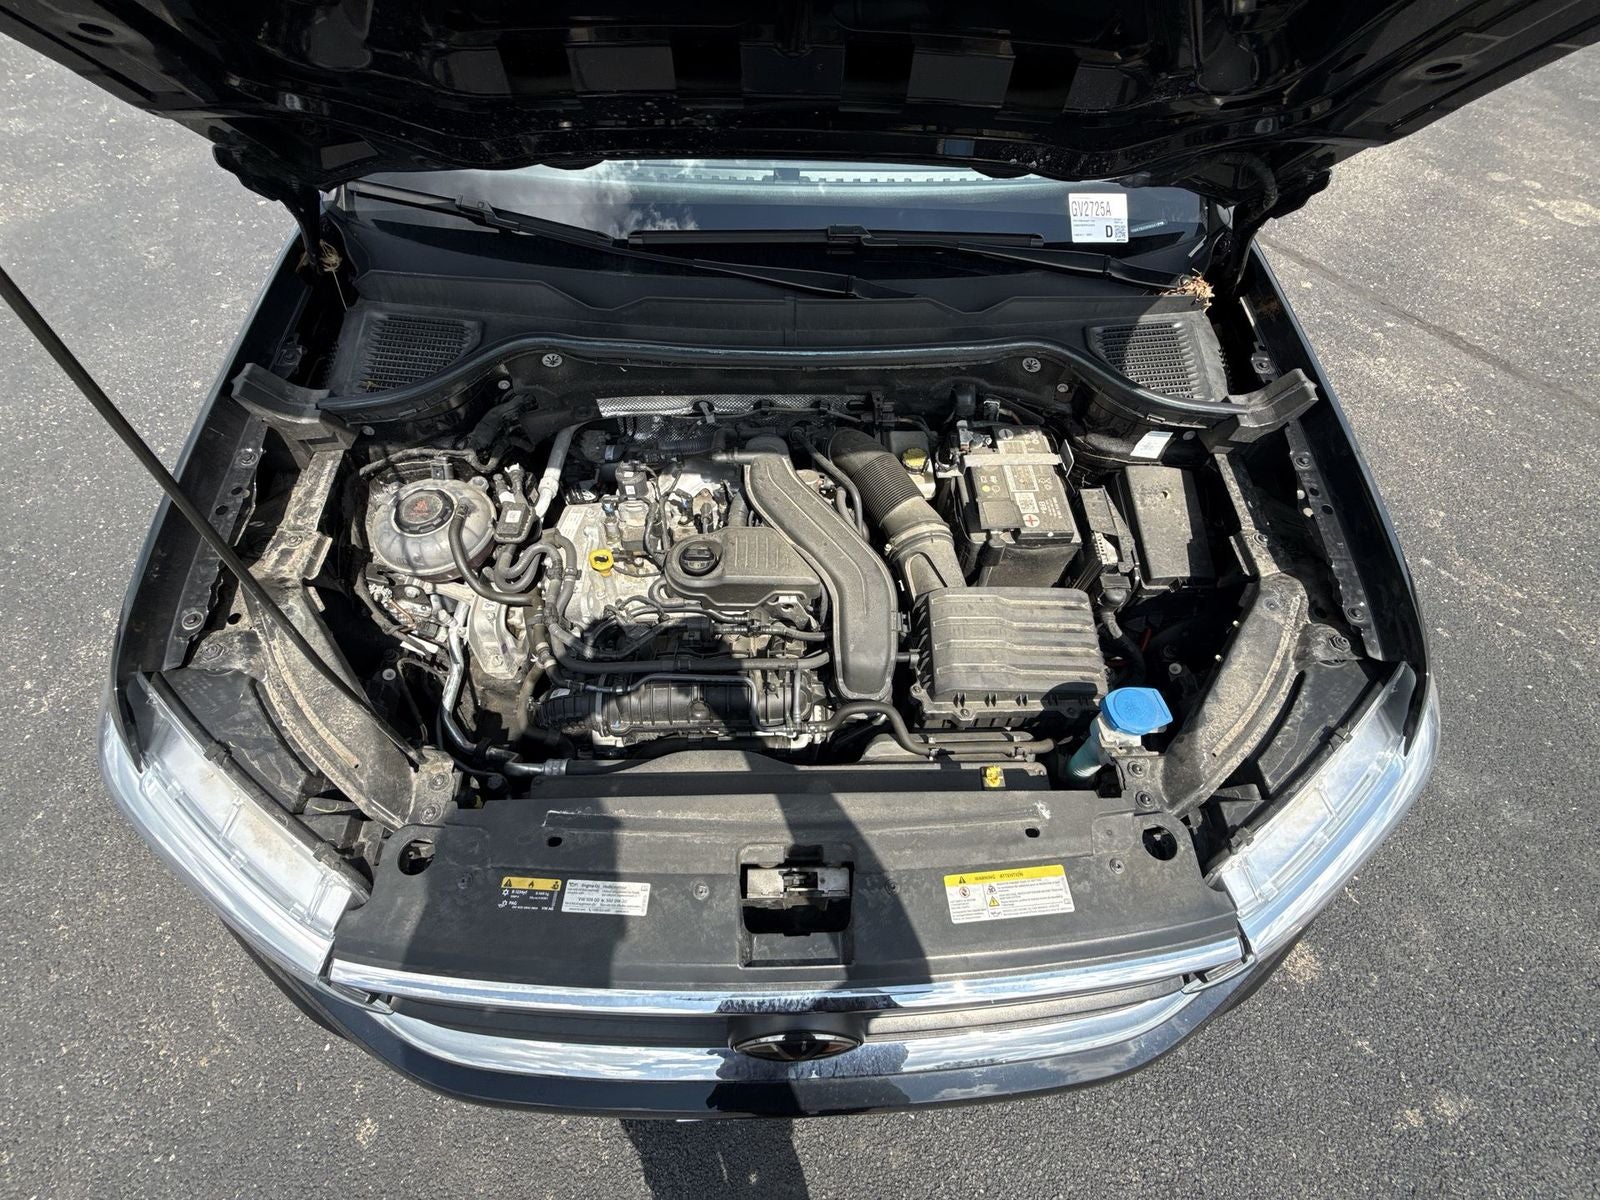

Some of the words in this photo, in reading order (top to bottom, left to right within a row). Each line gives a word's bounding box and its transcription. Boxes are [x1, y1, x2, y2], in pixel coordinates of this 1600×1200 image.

[1071, 200, 1112, 217] GV2725A
[1105, 225, 1113, 238] D
[999, 871, 1024, 879] ATTENTION
